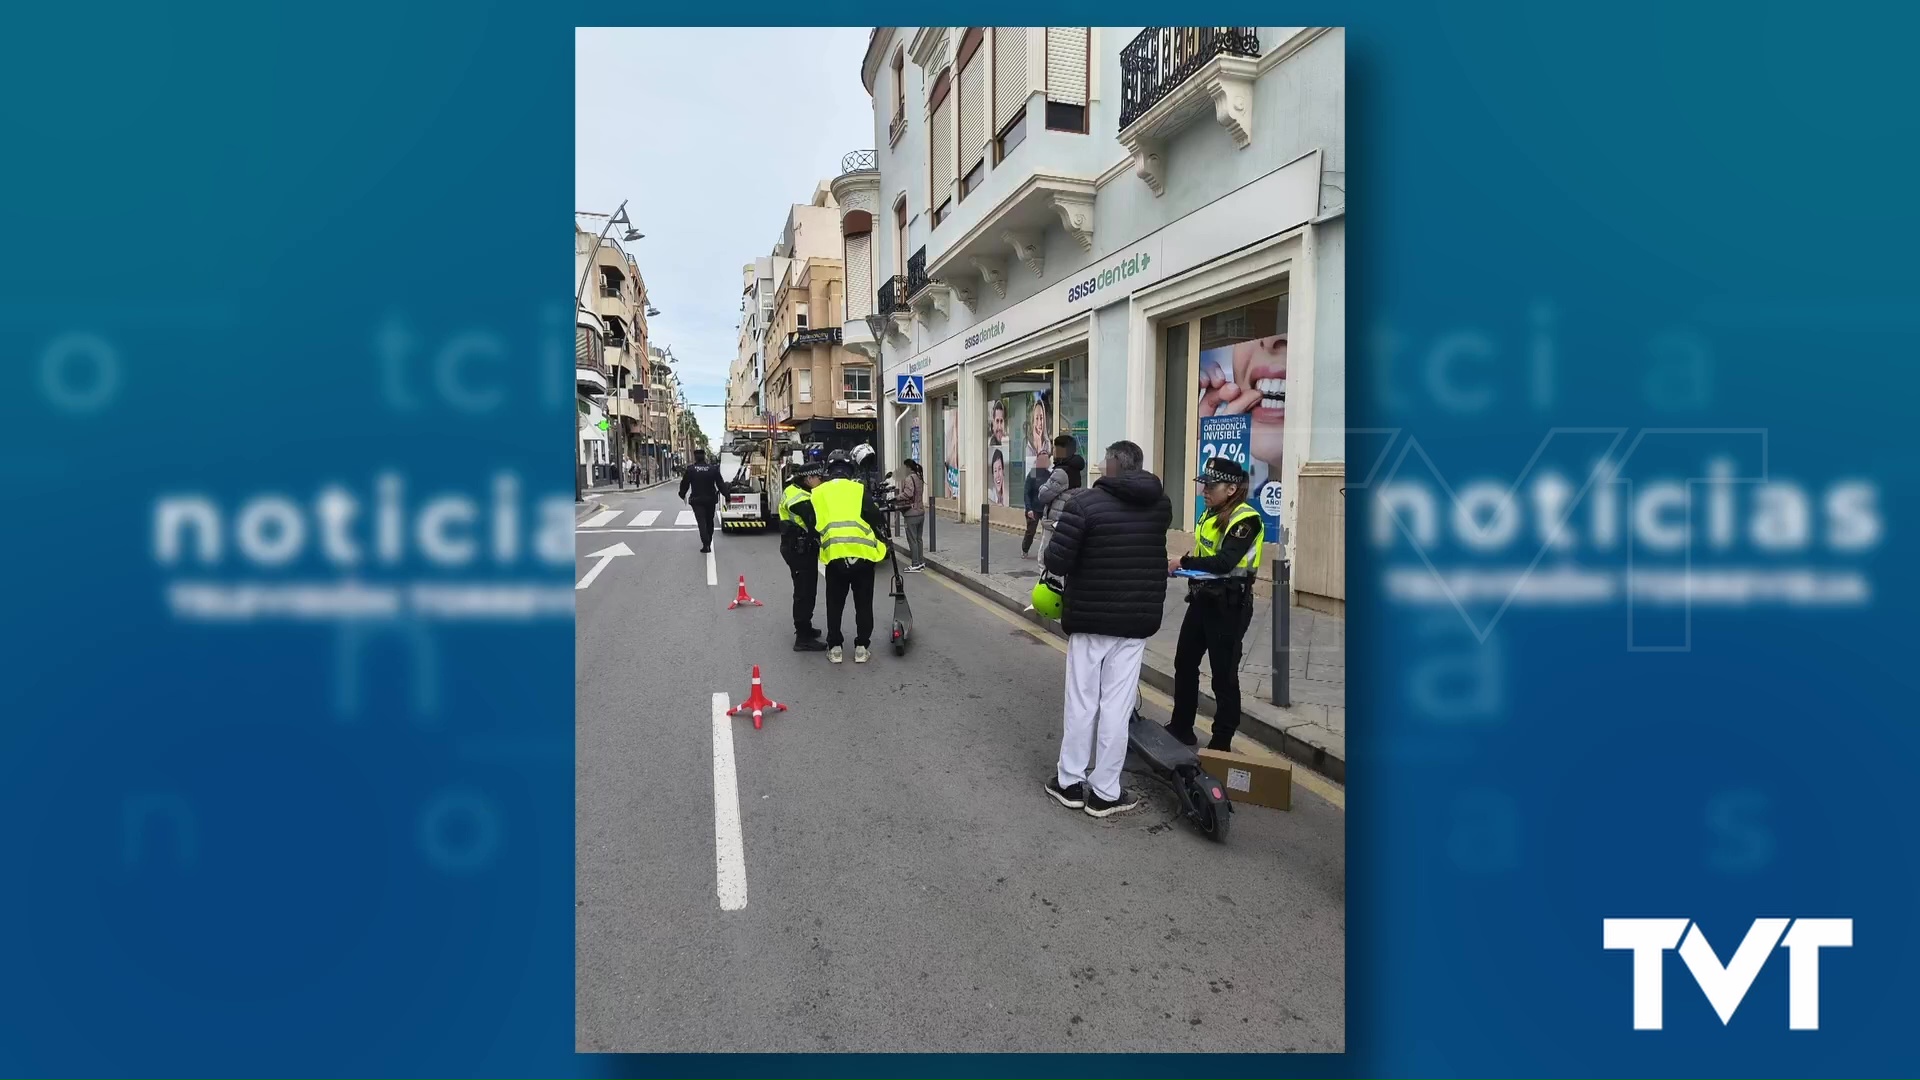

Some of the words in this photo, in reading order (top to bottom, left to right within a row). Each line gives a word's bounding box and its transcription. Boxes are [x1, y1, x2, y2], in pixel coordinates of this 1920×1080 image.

[1203, 422, 1247, 432] ORTODONCIA
[1203, 430, 1242, 440] INVISIBLE
[1266, 486, 1282, 499] 26
